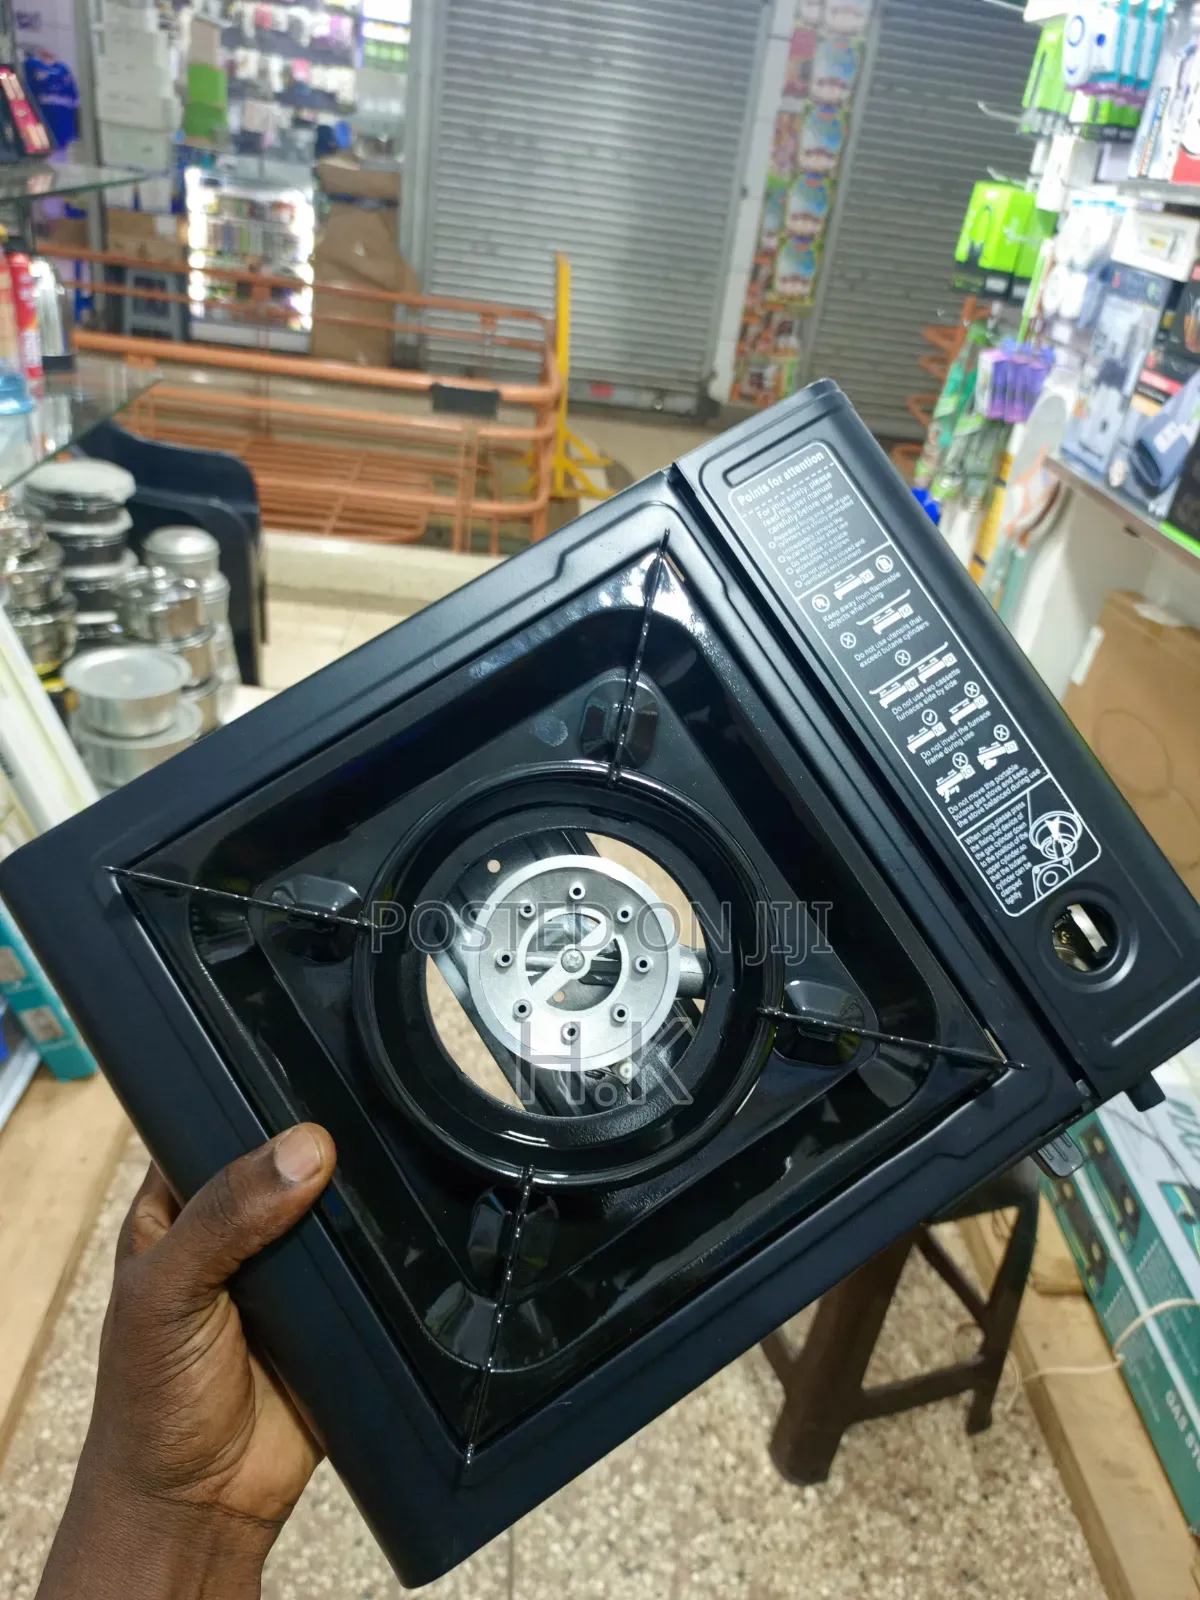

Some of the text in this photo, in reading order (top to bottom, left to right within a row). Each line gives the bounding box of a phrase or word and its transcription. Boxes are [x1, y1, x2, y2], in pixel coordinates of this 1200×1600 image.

[735, 449, 825, 506] Points for attention
[755, 506, 771, 519] For
[769, 498, 788, 512] your
[806, 470, 833, 490] please
[761, 481, 832, 526] read the user manual
[766, 492, 834, 535] carefully before use
[832, 515, 844, 524] the
[822, 570, 901, 623] Keep away from flammable
[826, 590, 885, 630] objects when using
[853, 615, 922, 661] Do not use utensils that
[858, 619, 930, 667] exceed butane cylinders
[891, 666, 961, 715] Do not use two cassette
[895, 678, 958, 721] furnaces side by side
[919, 709, 992, 759] Do not invert the furnace
[924, 730, 975, 766] frame during use
[947, 762, 1020, 814] Do not move the portable
[951, 765, 1029, 821] butane gas stove and keep
[956, 768, 1041, 828] the stove balanced during use
[964, 830, 982, 845] When
[1010, 801, 1027, 815] press
[969, 811, 1025, 853] the fixing rod device of
[974, 820, 1028, 860] the gas cylinder down
[979, 830, 1029, 868] to the position of the
[985, 862, 1002, 876] upper
[989, 853, 1027, 882] that the butane
[994, 861, 1032, 891] cylinder can be
[999, 878, 1023, 898] clamped
[1005, 890, 1023, 906] tightly
[1165, 1389, 1188, 1432] GAS
